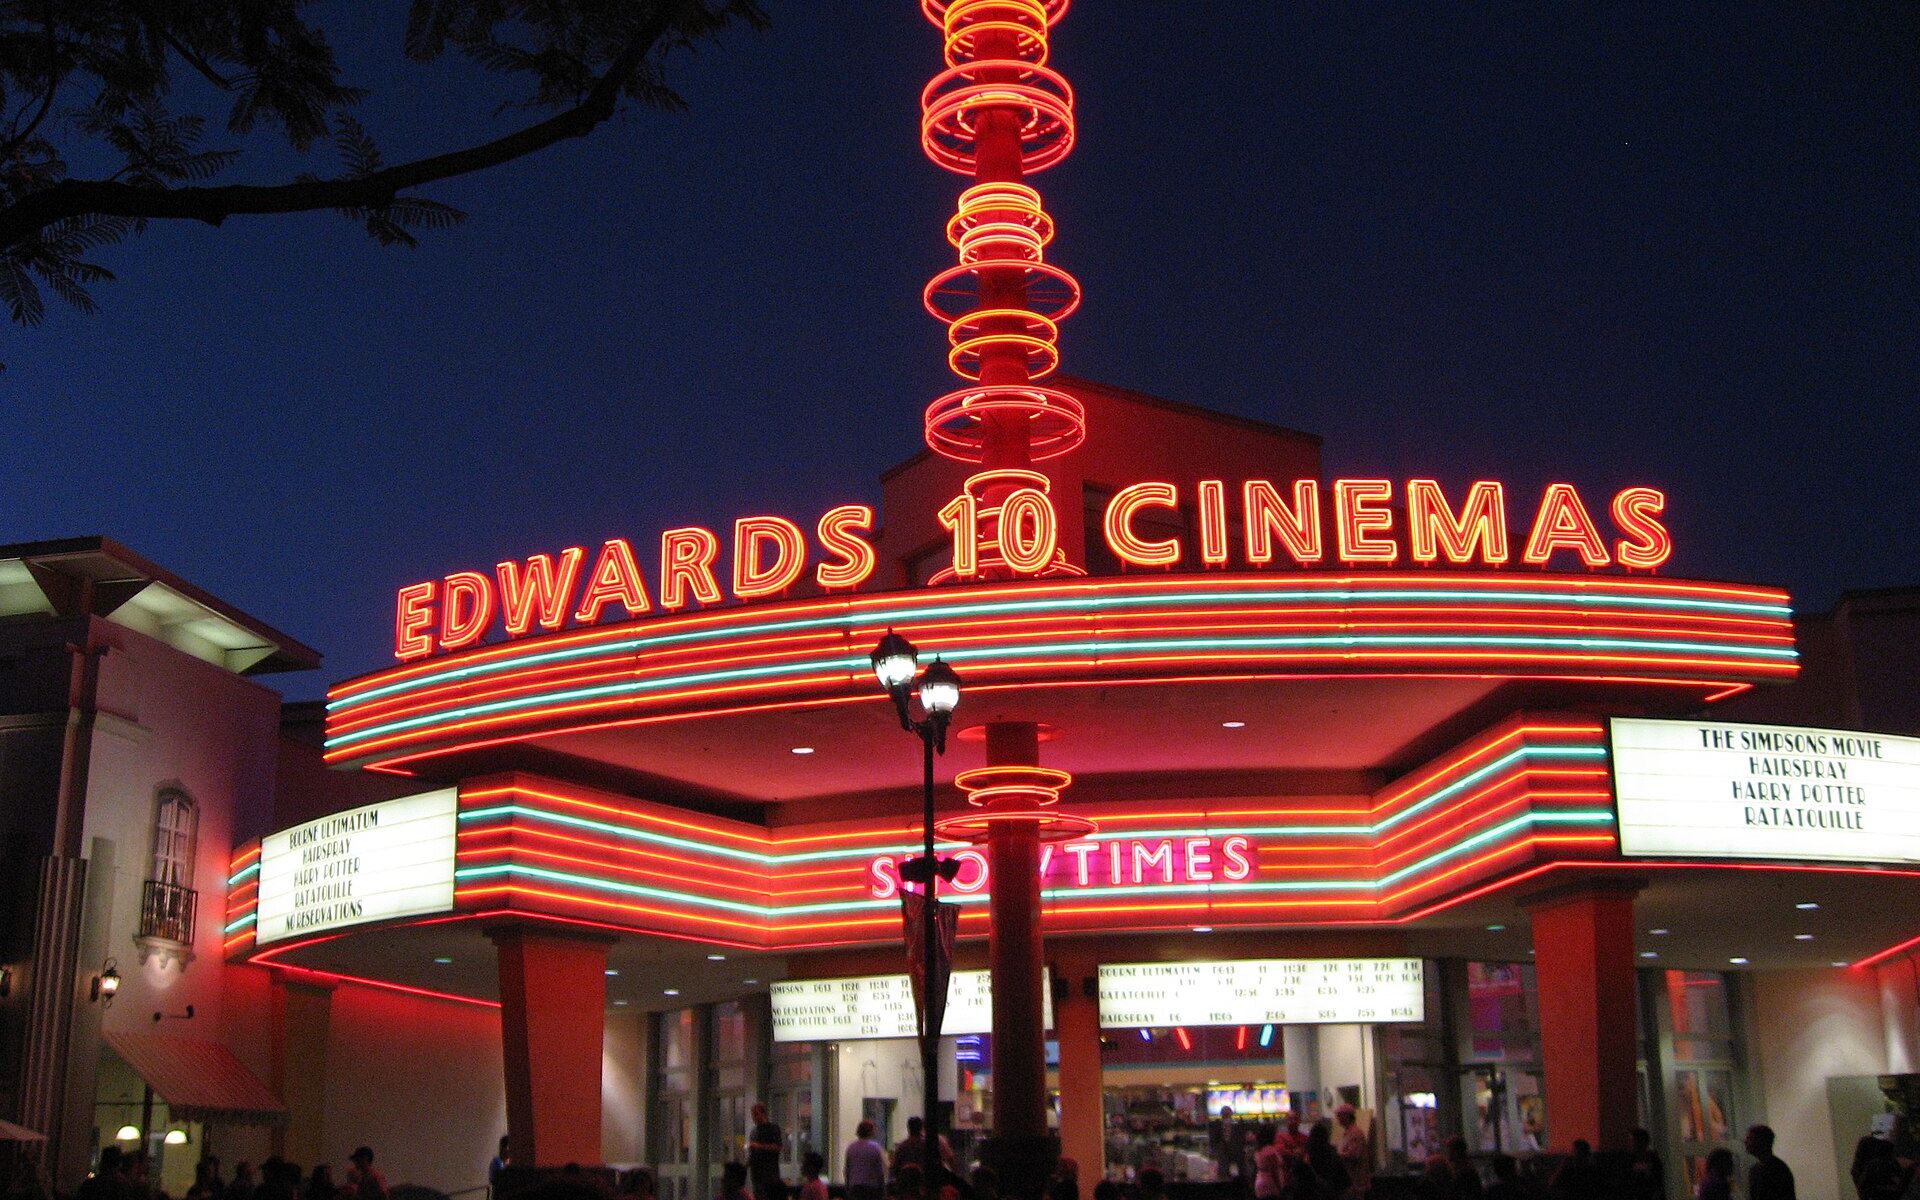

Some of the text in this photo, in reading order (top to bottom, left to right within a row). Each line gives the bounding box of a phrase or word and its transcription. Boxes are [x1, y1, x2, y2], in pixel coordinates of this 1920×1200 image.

[394, 478, 1673, 659] EDWARDS 10 CINEMAS
[1700, 729, 1883, 759] THE SIMPSONS MOVIE
[1749, 756, 1847, 780] HAIRSPRAY
[1732, 781, 1866, 805] HARRY POTTER
[290, 810, 379, 849] BOURNE ULTIMATUM
[1745, 807, 1864, 829] RATATOUILLE
[302, 837, 352, 865] HAIRSPRAY
[294, 857, 360, 888] HARRY POTTER
[871, 836, 1250, 898] SOTIMES
[295, 880, 353, 908] RATATOUILLE
[285, 899, 363, 931] NO RESERVATIONS
